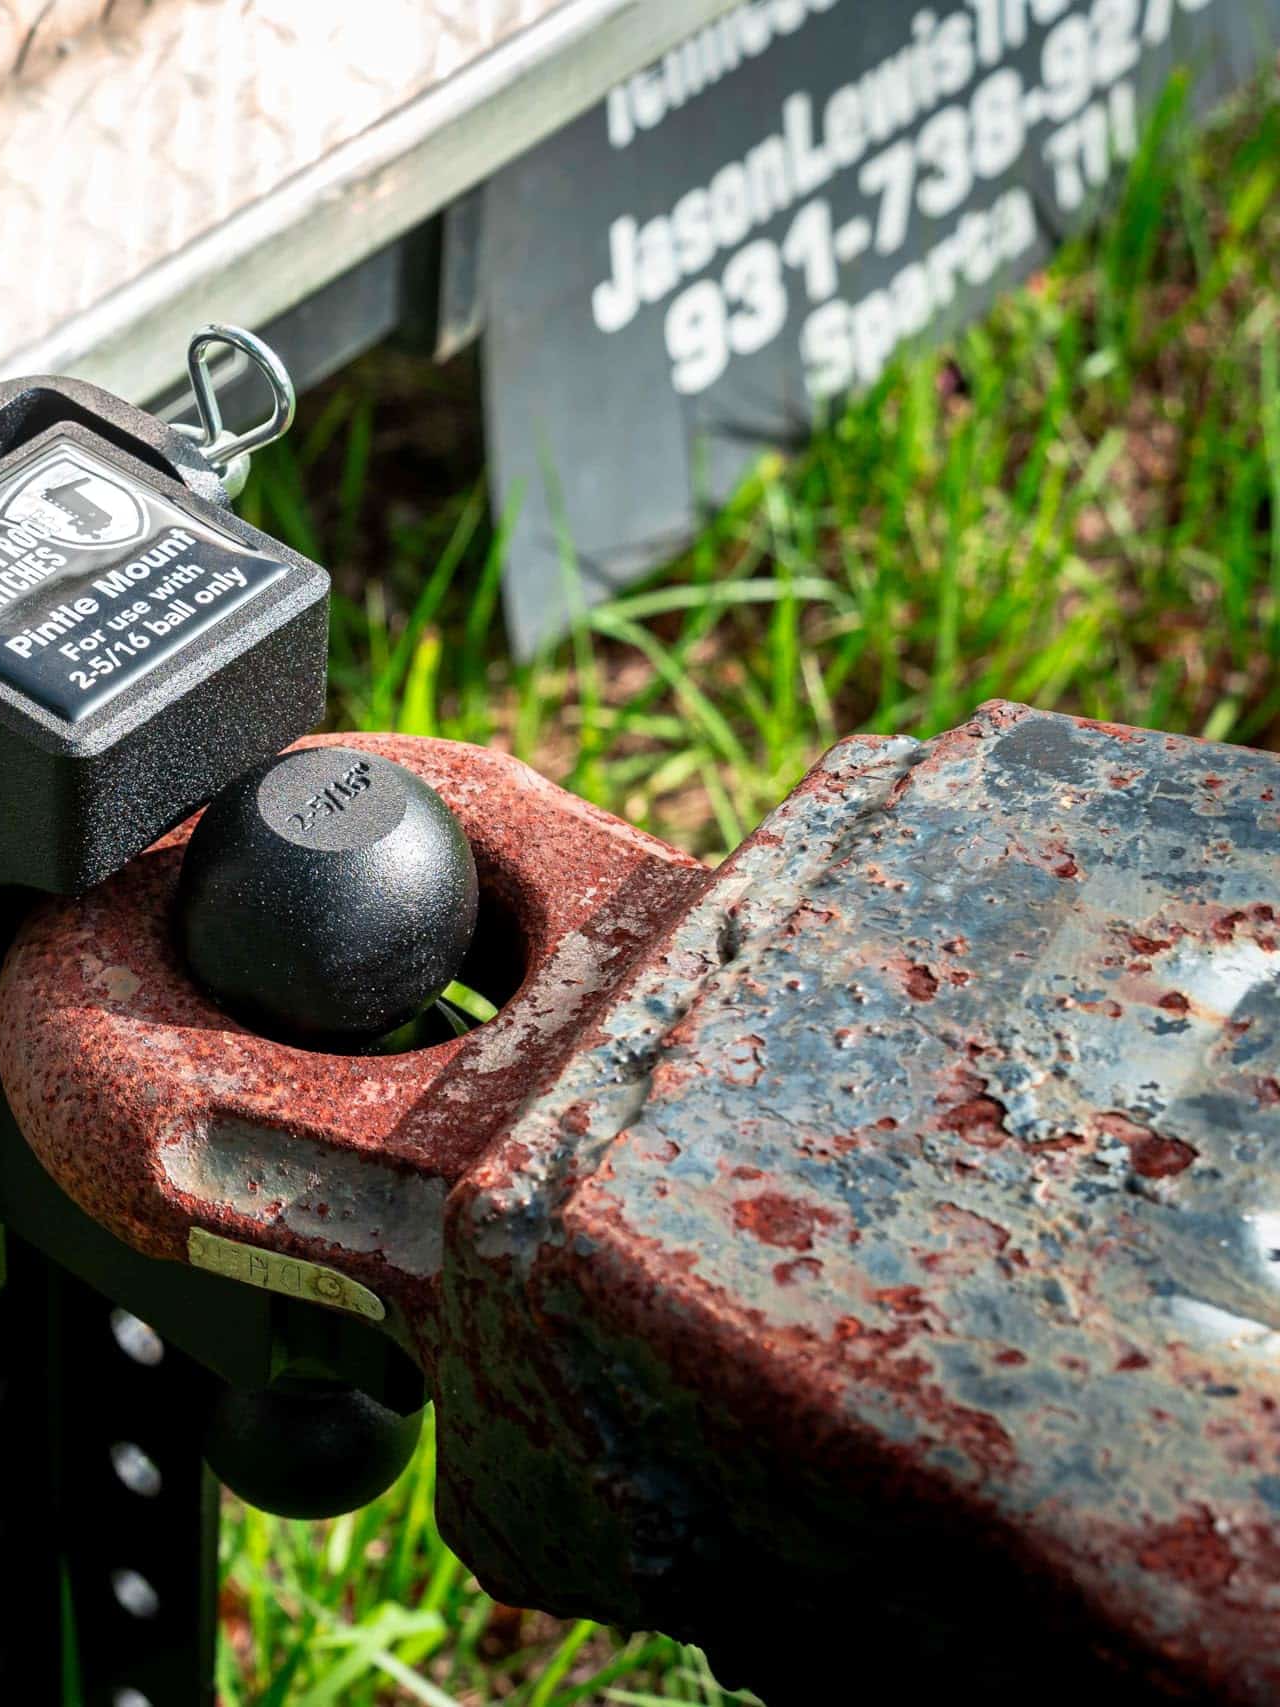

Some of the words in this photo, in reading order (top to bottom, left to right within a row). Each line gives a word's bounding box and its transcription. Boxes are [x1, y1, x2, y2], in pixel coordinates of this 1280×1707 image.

[665, 0, 1210, 395] 931-738-92
[799, 187, 1037, 400] Sparta
[4, 597, 100, 659] Pintle
[92, 528, 198, 599] Mount
[58, 628, 107, 662] For
[106, 601, 152, 632] use
[148, 562, 206, 602] with
[69, 631, 152, 690] 2-5/16
[142, 599, 197, 637] ball
[194, 566, 248, 604] only
